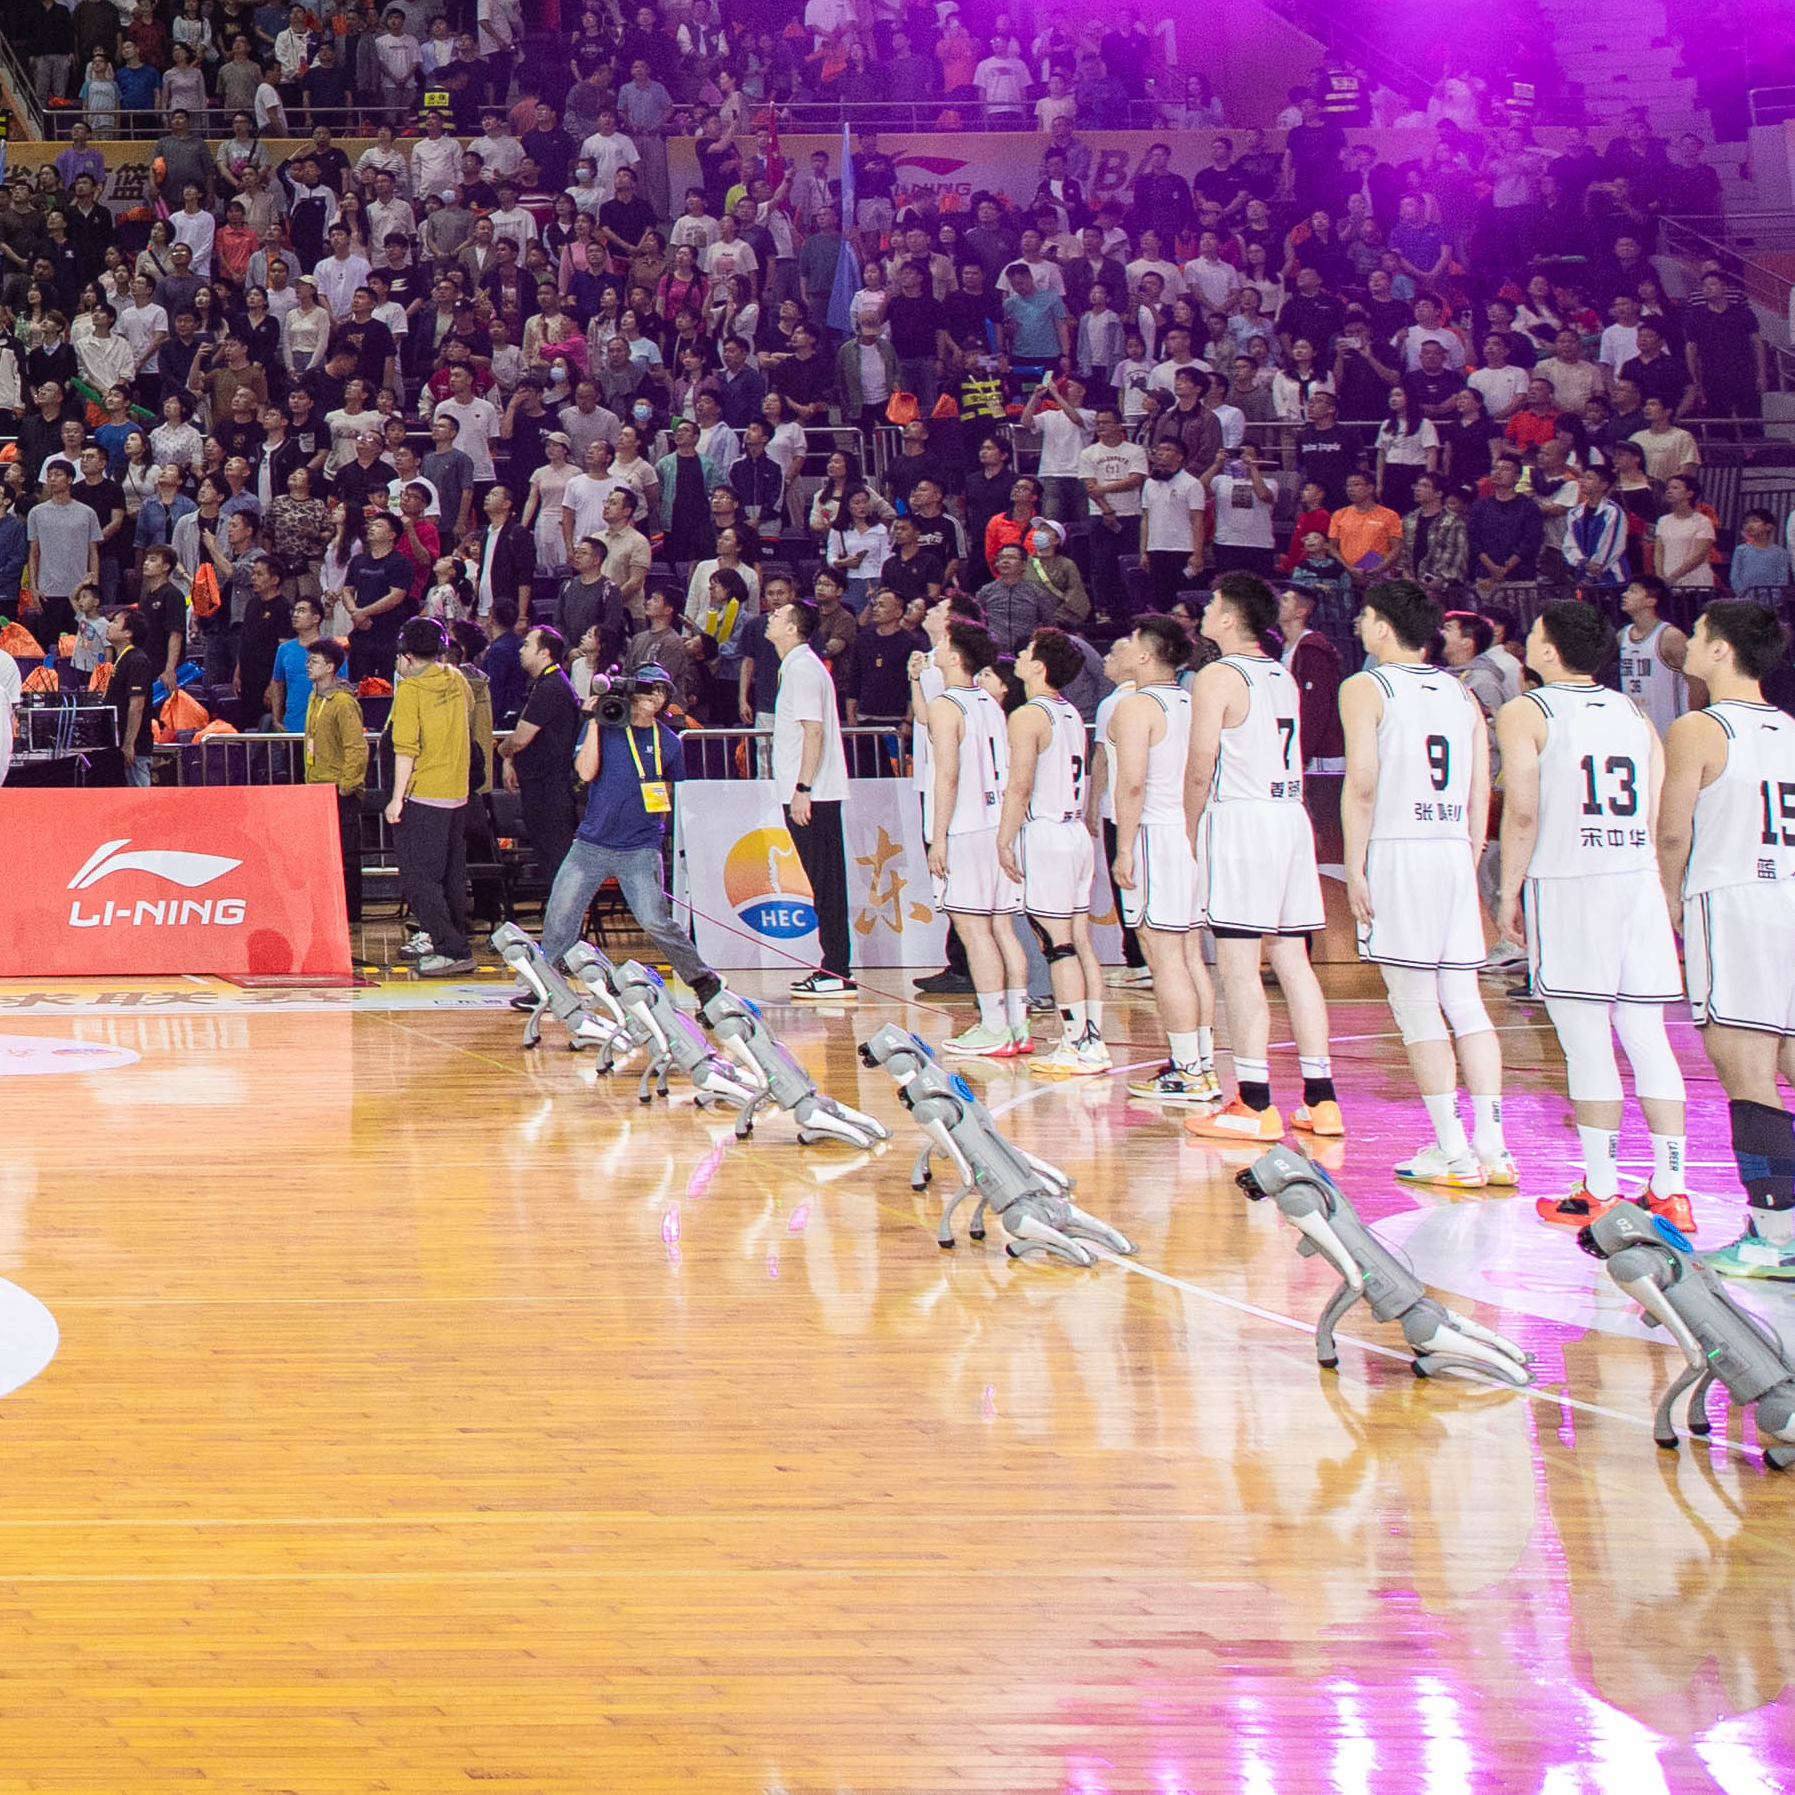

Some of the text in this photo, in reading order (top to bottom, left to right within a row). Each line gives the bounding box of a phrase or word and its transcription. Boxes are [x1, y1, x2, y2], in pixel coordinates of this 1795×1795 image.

[1276, 718, 1295, 770] 7
[1426, 734, 1449, 791] 9
[1580, 755, 1638, 816] 13
[1761, 781, 1795, 847] 15
[68, 898, 247, 927] LI-NING
[761, 910, 806, 928] HEC
